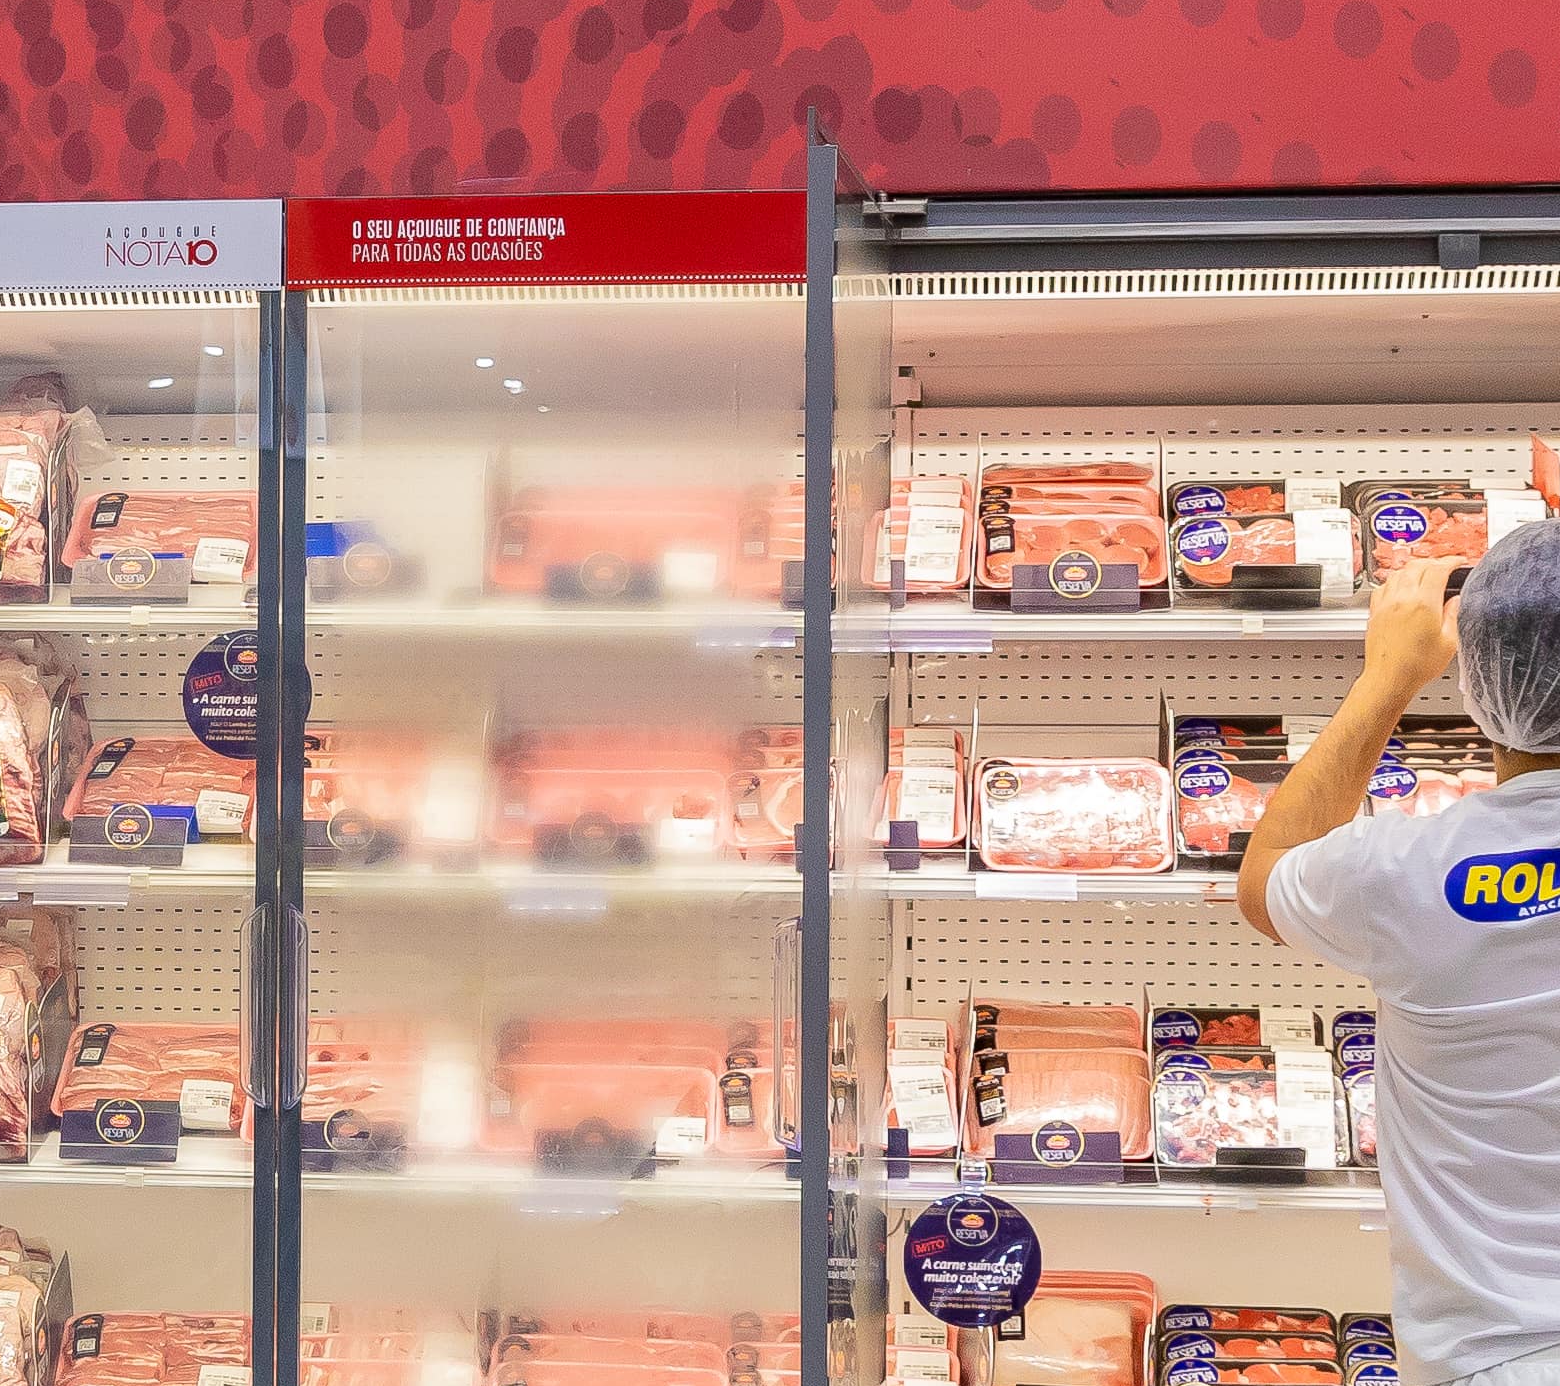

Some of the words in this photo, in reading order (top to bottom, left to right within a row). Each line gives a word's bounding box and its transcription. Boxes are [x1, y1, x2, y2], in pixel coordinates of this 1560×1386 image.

[106, 226, 216, 238] AÇOUGUE
[353, 221, 362, 239] O
[367, 220, 391, 239] SEU
[397, 219, 460, 241] AÇOUGUE
[466, 218, 482, 237] DE
[487, 217, 565, 241] CONFIANÇA
[106, 239, 218, 267] NOTA10
[353, 243, 389, 262] PARA
[395, 242, 441, 261] TODAS
[447, 242, 465, 261] AS
[471, 237, 543, 261] OCASIÕES
[1177, 496, 1223, 511] RESERVA
[1375, 519, 1424, 532] RESERVA
[1180, 532, 1227, 551] RESERVA
[200, 694, 208, 704] A
[211, 695, 241, 704] carne
[201, 705, 233, 716] muito
[1180, 775, 1227, 789] RESERVA
[1368, 773, 1415, 791] RESERVA
[1153, 1026, 1198, 1038] RESERVA
[104, 1127, 135, 1138] RESERVA
[922, 1258, 932, 1270] A
[933, 1261, 966, 1270] carne
[923, 1271, 958, 1283] muito
[960, 1272, 1022, 1285] colesterol?
[1166, 1315, 1210, 1329] RESERVA
[1168, 1342, 1214, 1359] RESERVA
[1169, 1370, 1217, 1386] RESERVA
